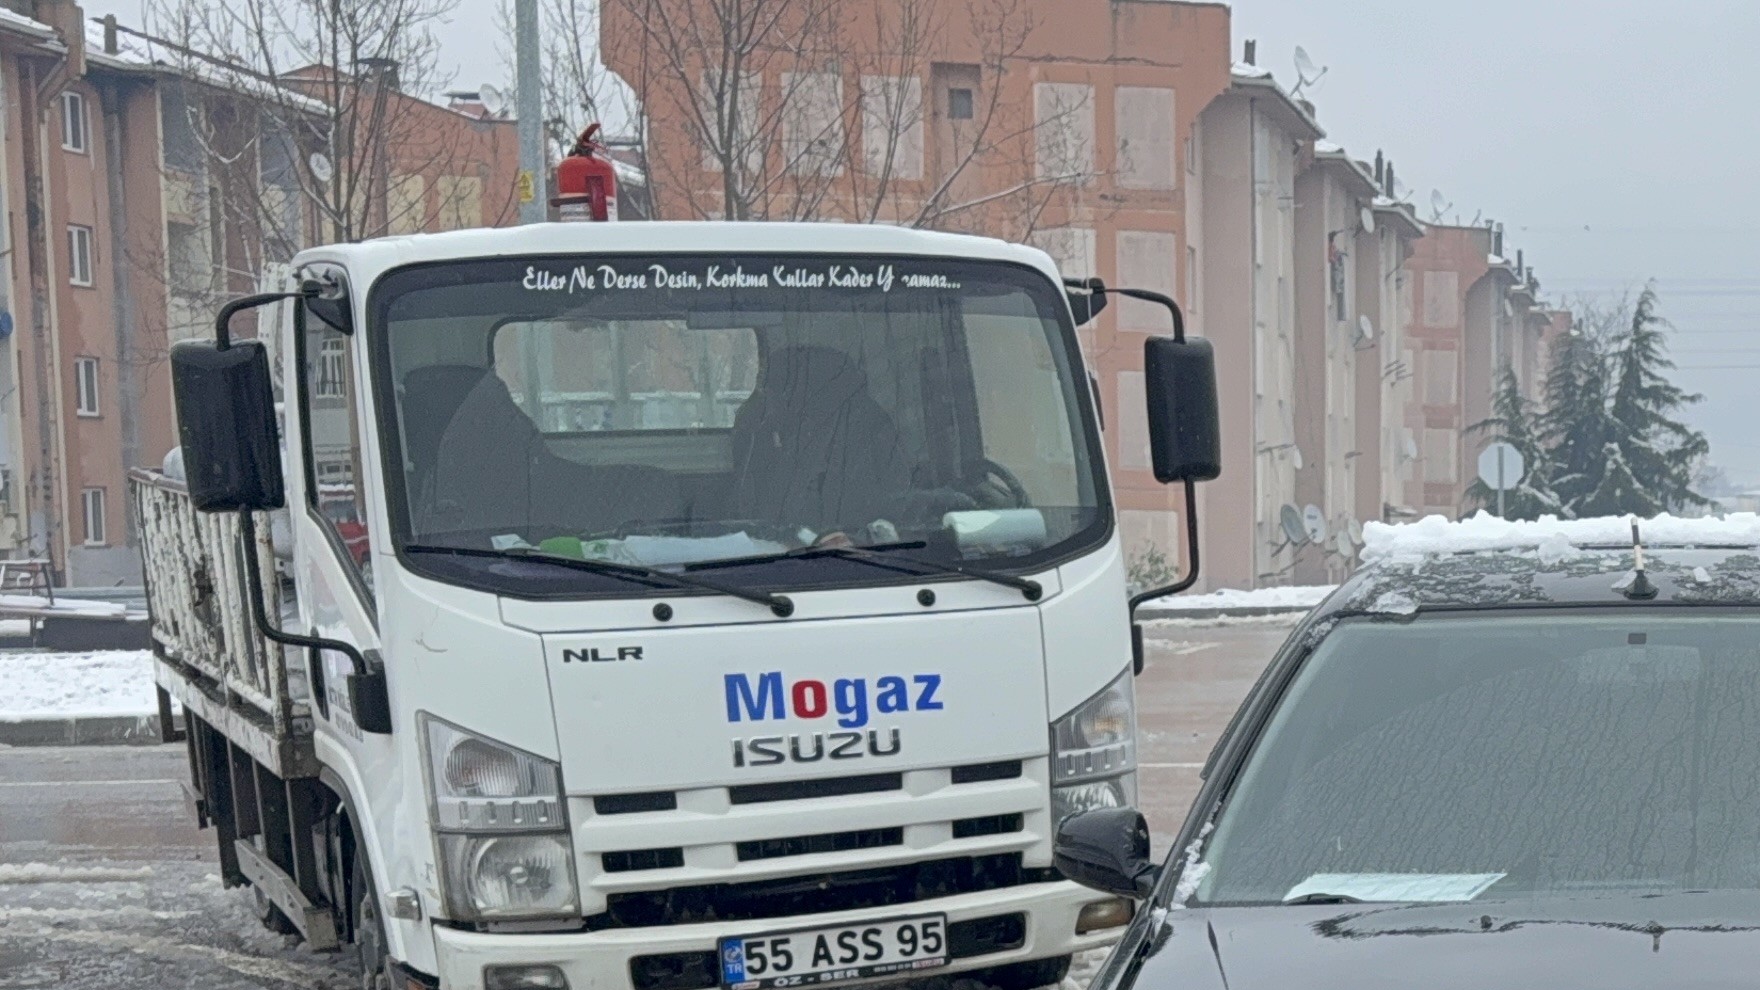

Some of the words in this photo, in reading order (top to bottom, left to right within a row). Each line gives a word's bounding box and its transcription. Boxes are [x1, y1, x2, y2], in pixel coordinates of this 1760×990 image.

[523, 265, 567, 291] Eller
[568, 265, 596, 294] Ne
[597, 264, 647, 289] Derse
[649, 264, 702, 290] Desin,
[706, 265, 769, 288] Korkma
[828, 264, 874, 288] Kader
[563, 646, 644, 663] NLR
[723, 671, 944, 729] Mogaz
[730, 727, 902, 768] ISUZU
[744, 937, 794, 976] 55
[810, 927, 884, 969] ASS
[896, 921, 943, 957] 95
[727, 962, 743, 974] TR
